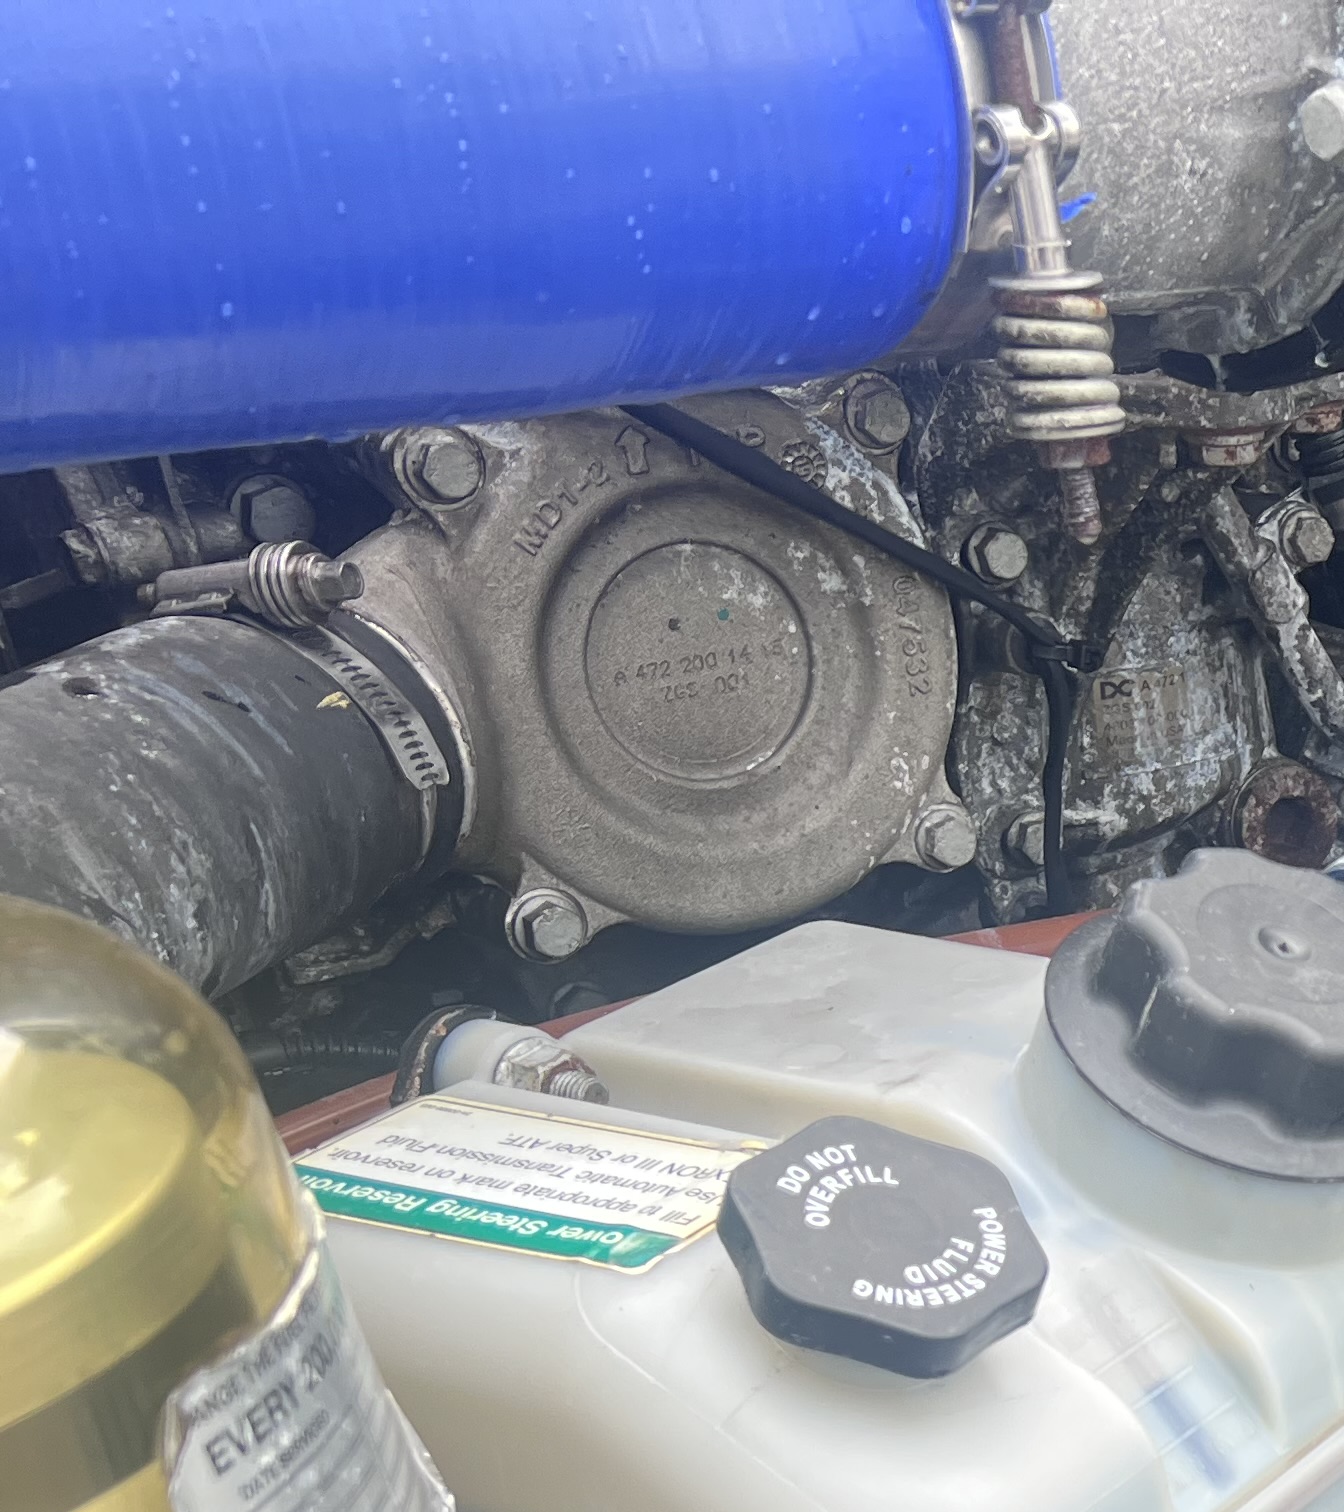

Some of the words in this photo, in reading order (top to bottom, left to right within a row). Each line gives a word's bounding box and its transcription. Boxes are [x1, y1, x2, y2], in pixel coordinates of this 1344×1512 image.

[636, 660, 672, 680] 472
[682, 651, 719, 675] 200
[380, 1133, 435, 1154] Fluid
[545, 1139, 612, 1164] Super
[327, 1146, 425, 1177] reservoir.
[430, 1167, 457, 1182] on
[439, 1144, 573, 1183] Transmission
[613, 1153, 635, 1166] or
[777, 1165, 810, 1193] DO
[805, 1144, 856, 1170] NOT
[462, 1170, 511, 1194] mark
[574, 1170, 680, 1200] Automatic
[513, 1181, 631, 1217] appropriate
[640, 1203, 663, 1217] to
[804, 1166, 899, 1229] OVERFILL
[428, 1199, 548, 1236] Steering
[668, 1208, 701, 1227] Fill
[546, 1224, 624, 1247] ower
[973, 1207, 1006, 1277] POWER
[904, 1237, 975, 1284] FLUID
[853, 1273, 985, 1307] STEERING
[206, 1374, 299, 1477] EVERY
